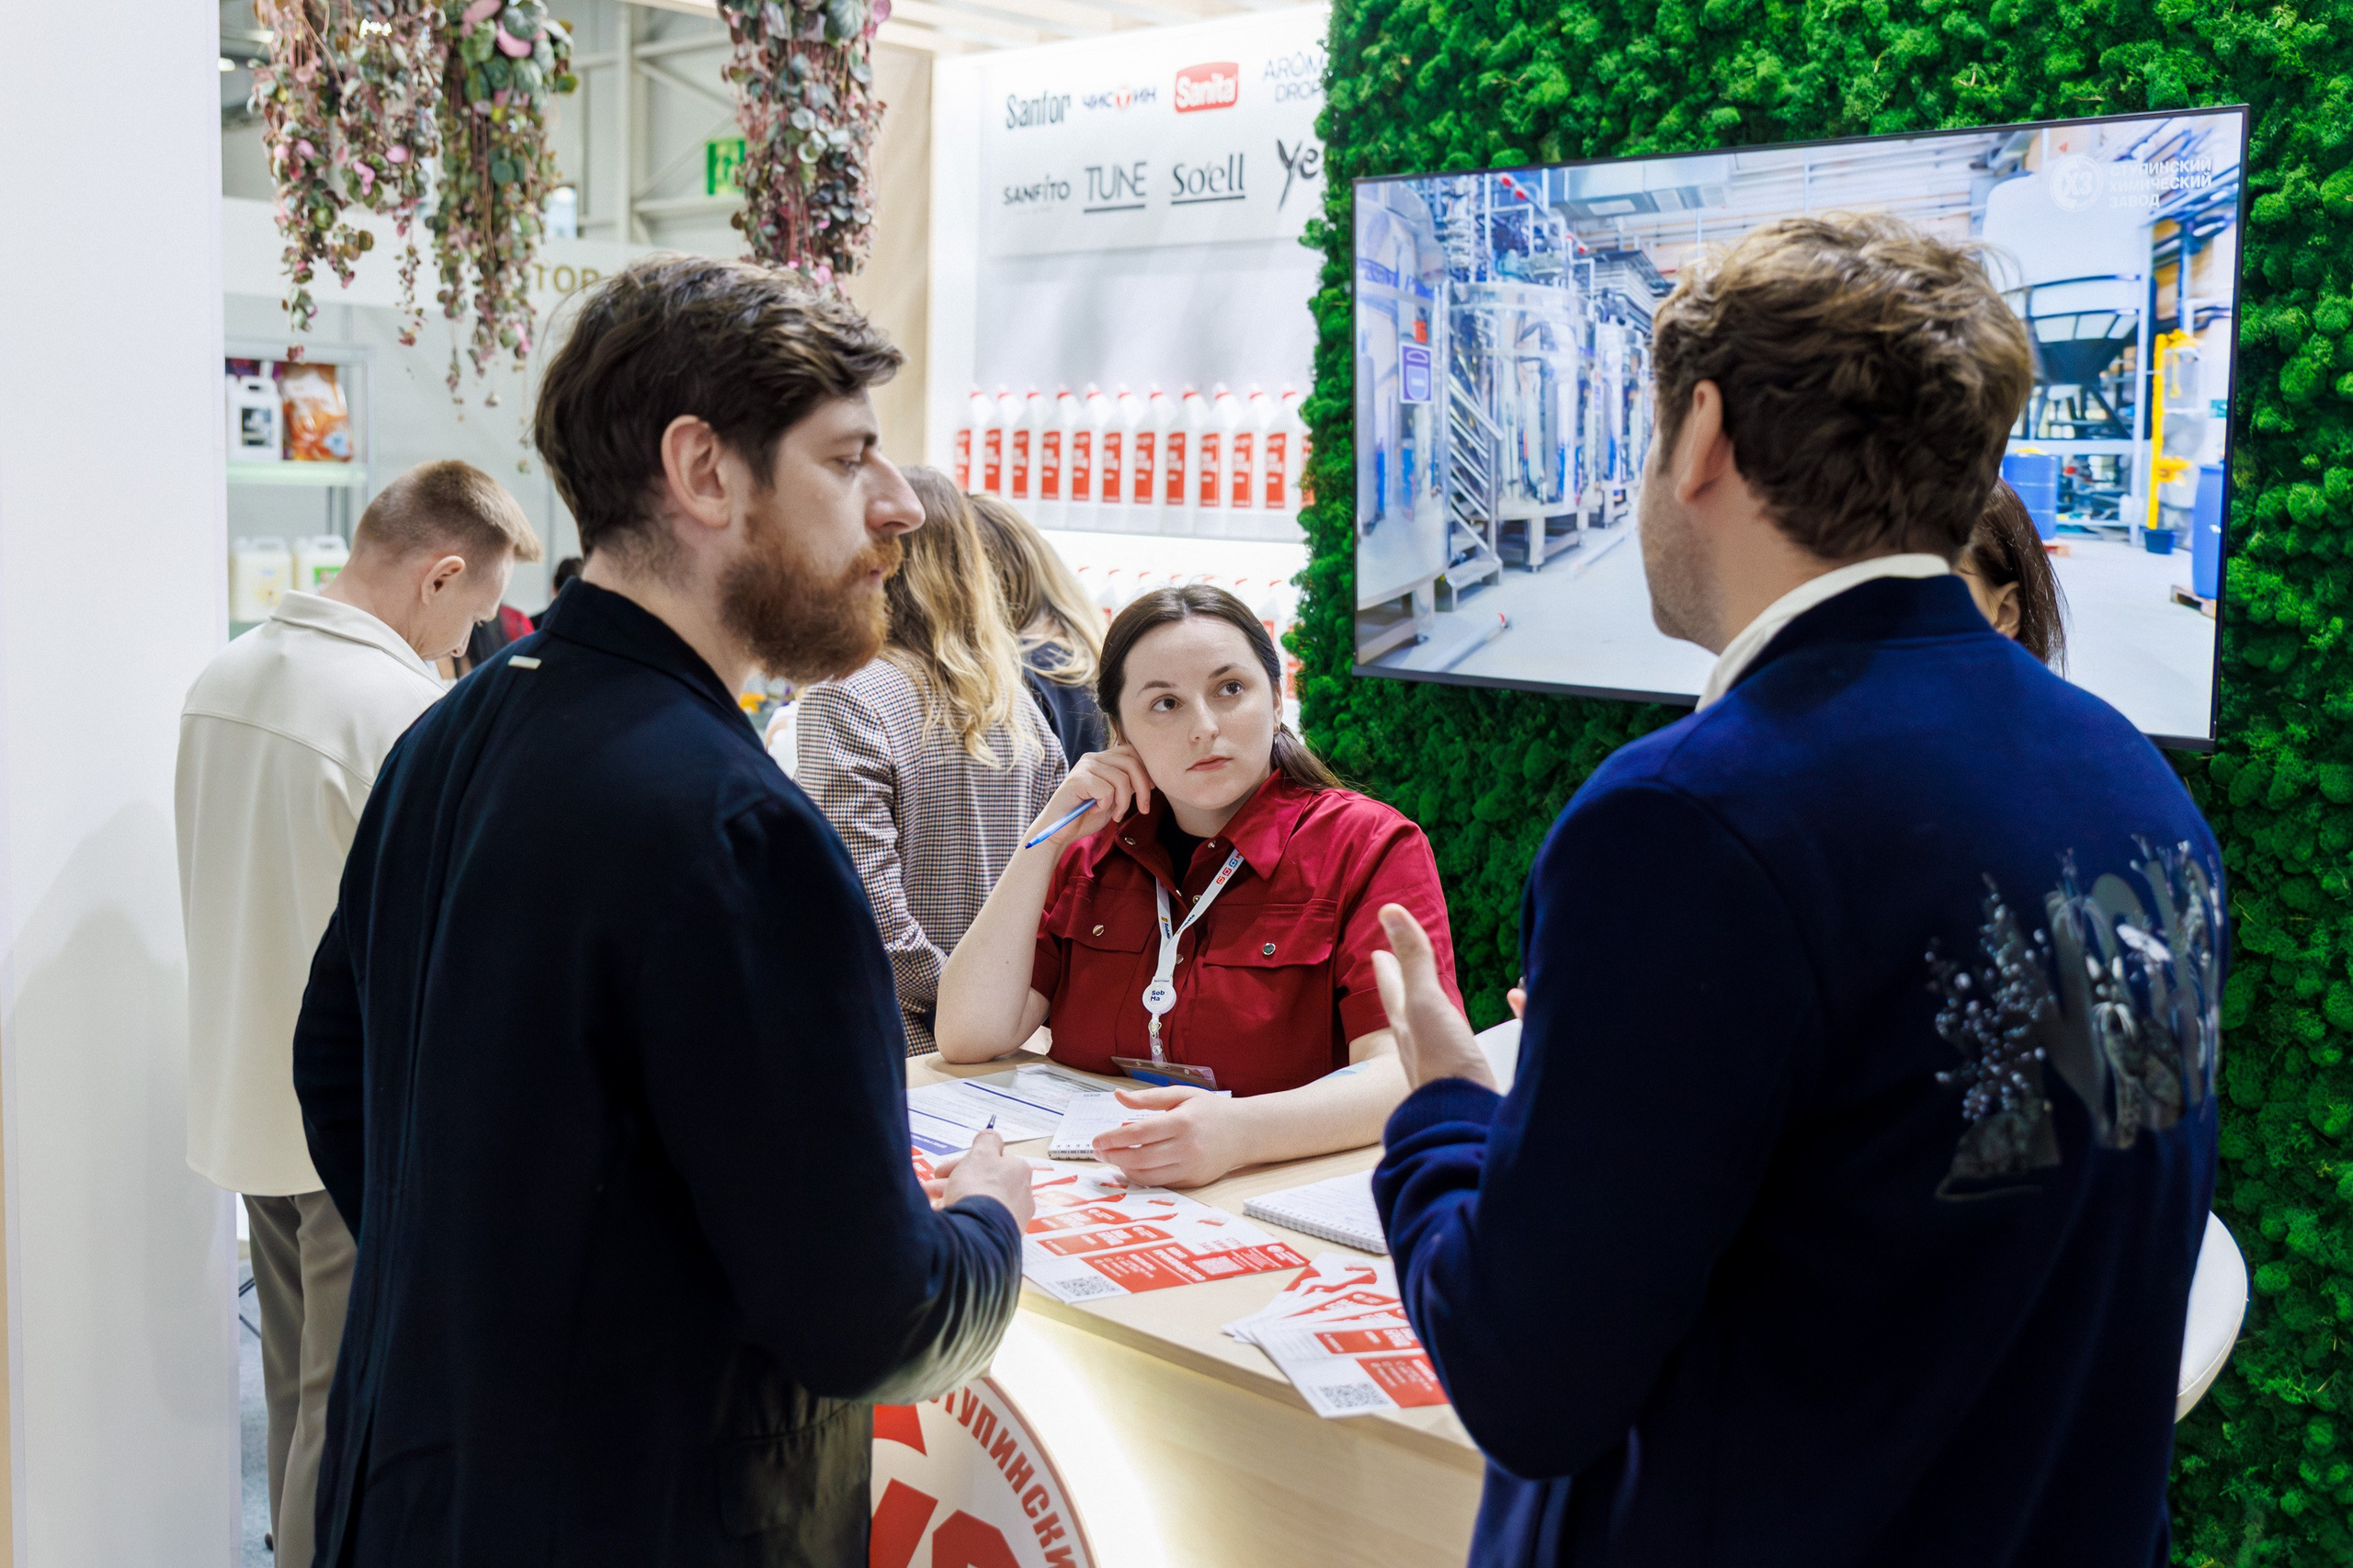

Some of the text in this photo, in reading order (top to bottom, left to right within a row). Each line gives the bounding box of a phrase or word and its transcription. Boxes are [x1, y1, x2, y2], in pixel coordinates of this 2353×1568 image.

[1006, 90, 1071, 129] Sanfor
[1085, 162, 1147, 201] TUNE
[2109, 173, 2212, 194] ХИМИЧЕСКИЙ
[2109, 194, 2160, 209] ЗАВОД
